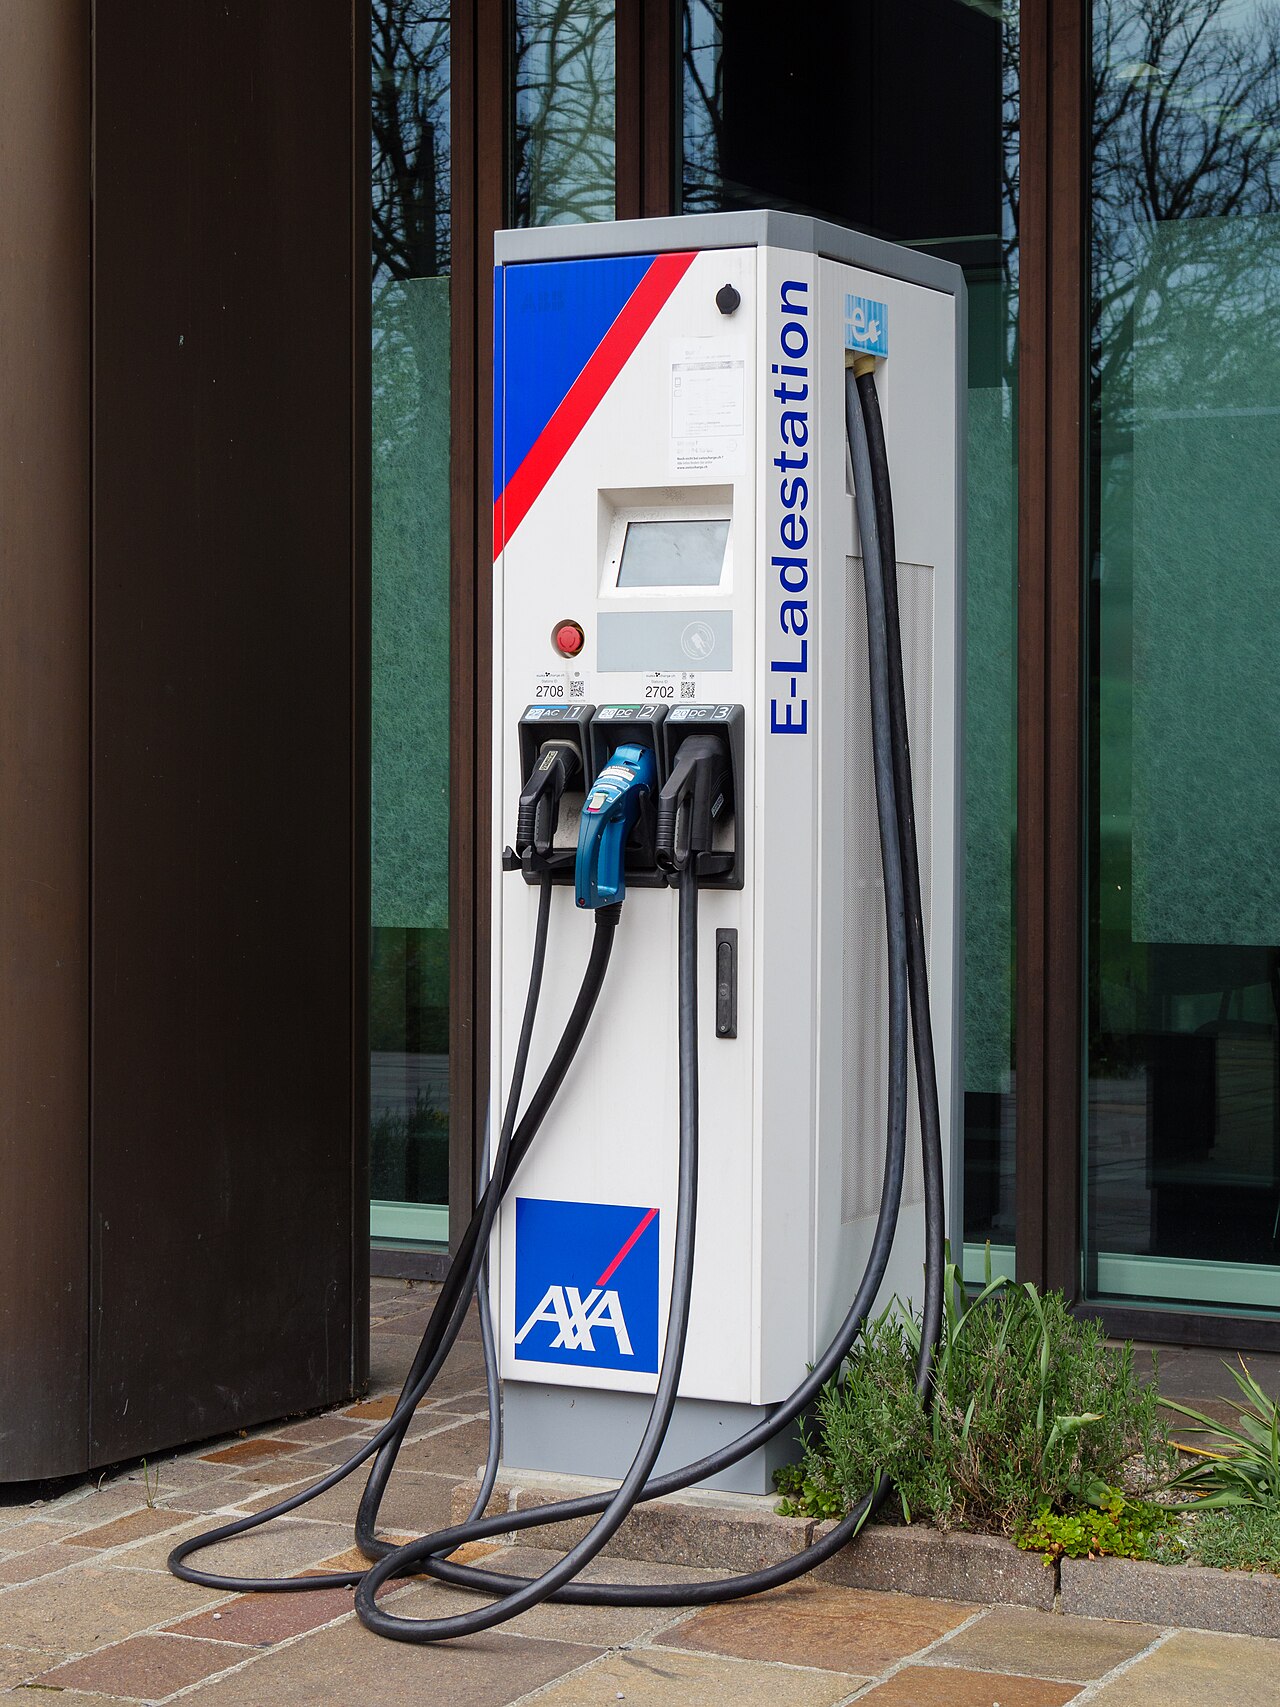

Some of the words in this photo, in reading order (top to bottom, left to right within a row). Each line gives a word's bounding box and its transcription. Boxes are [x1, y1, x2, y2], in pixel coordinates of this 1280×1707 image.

[771, 280, 809, 734] E-Ladestation
[536, 685, 564, 698] 2708
[645, 685, 675, 698] 2702
[542, 709, 560, 717] AC
[571, 706, 581, 718] 1
[640, 706, 655, 717] 2
[689, 709, 707, 717] DC
[714, 706, 730, 718] 3
[515, 1285, 635, 1356] AXA
